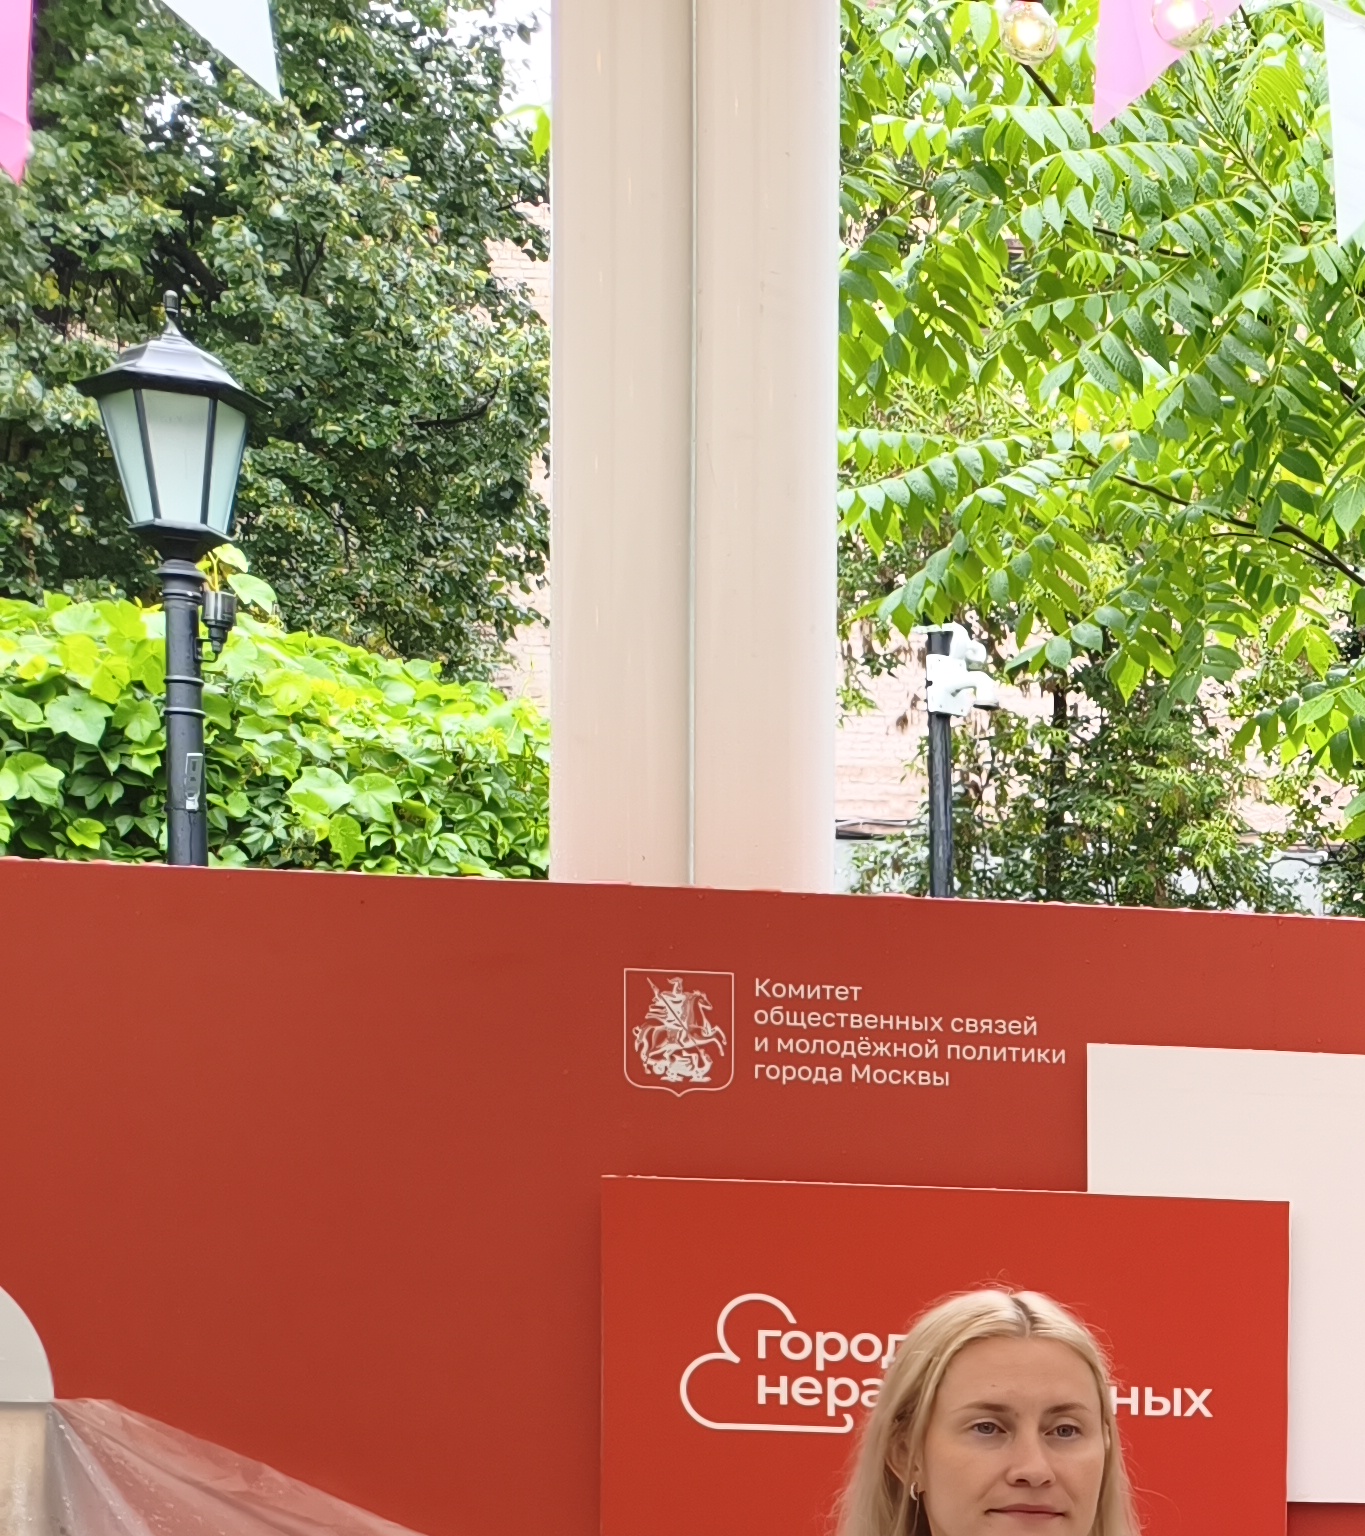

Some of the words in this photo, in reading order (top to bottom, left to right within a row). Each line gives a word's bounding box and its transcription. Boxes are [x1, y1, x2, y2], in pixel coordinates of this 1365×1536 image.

[754, 978, 862, 1001] Комитет
[753, 1006, 944, 1032] общественных
[950, 1016, 1038, 1036] связей
[754, 1037, 769, 1052] и
[777, 1036, 939, 1059] молодёжной
[947, 1044, 1066, 1064] политики
[754, 1063, 843, 1085] города
[851, 1063, 950, 1086] Москвы
